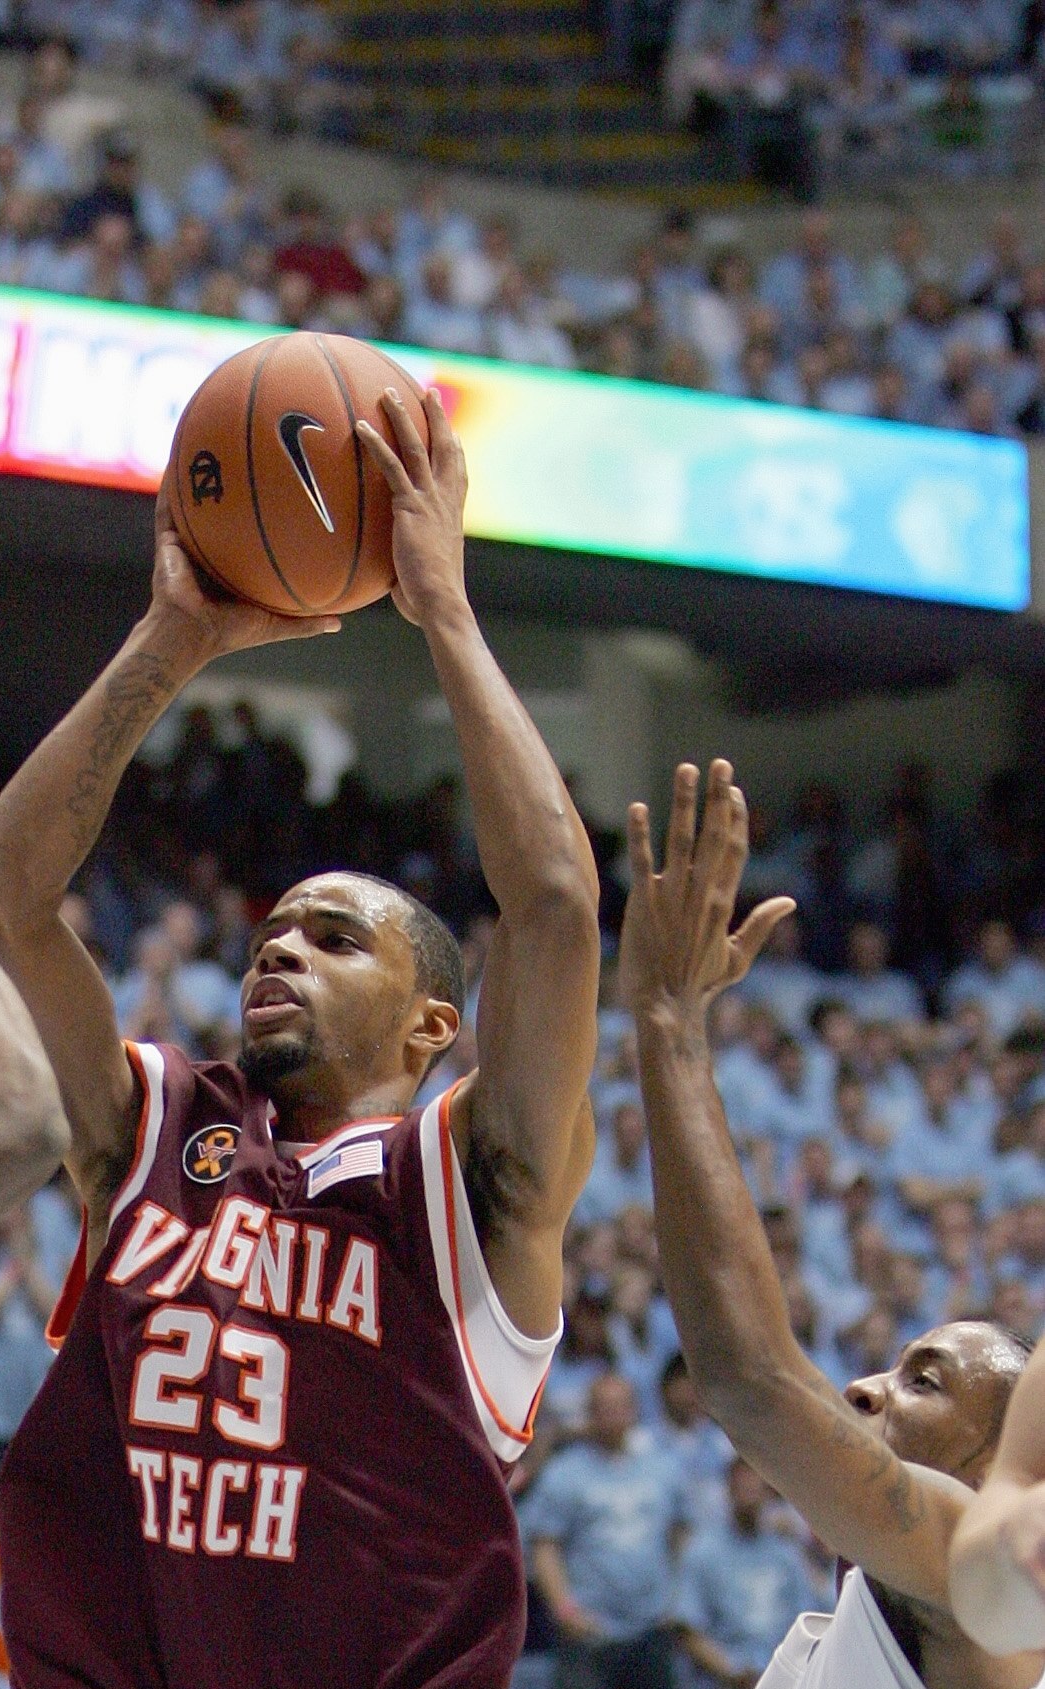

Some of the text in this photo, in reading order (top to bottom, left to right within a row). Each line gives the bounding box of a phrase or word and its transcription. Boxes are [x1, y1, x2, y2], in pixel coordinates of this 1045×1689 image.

[14, 322, 216, 478] NO
[105, 1193, 382, 1347] VIGNIA
[126, 1302, 292, 1452] 23
[125, 1446, 308, 1563] TECH
